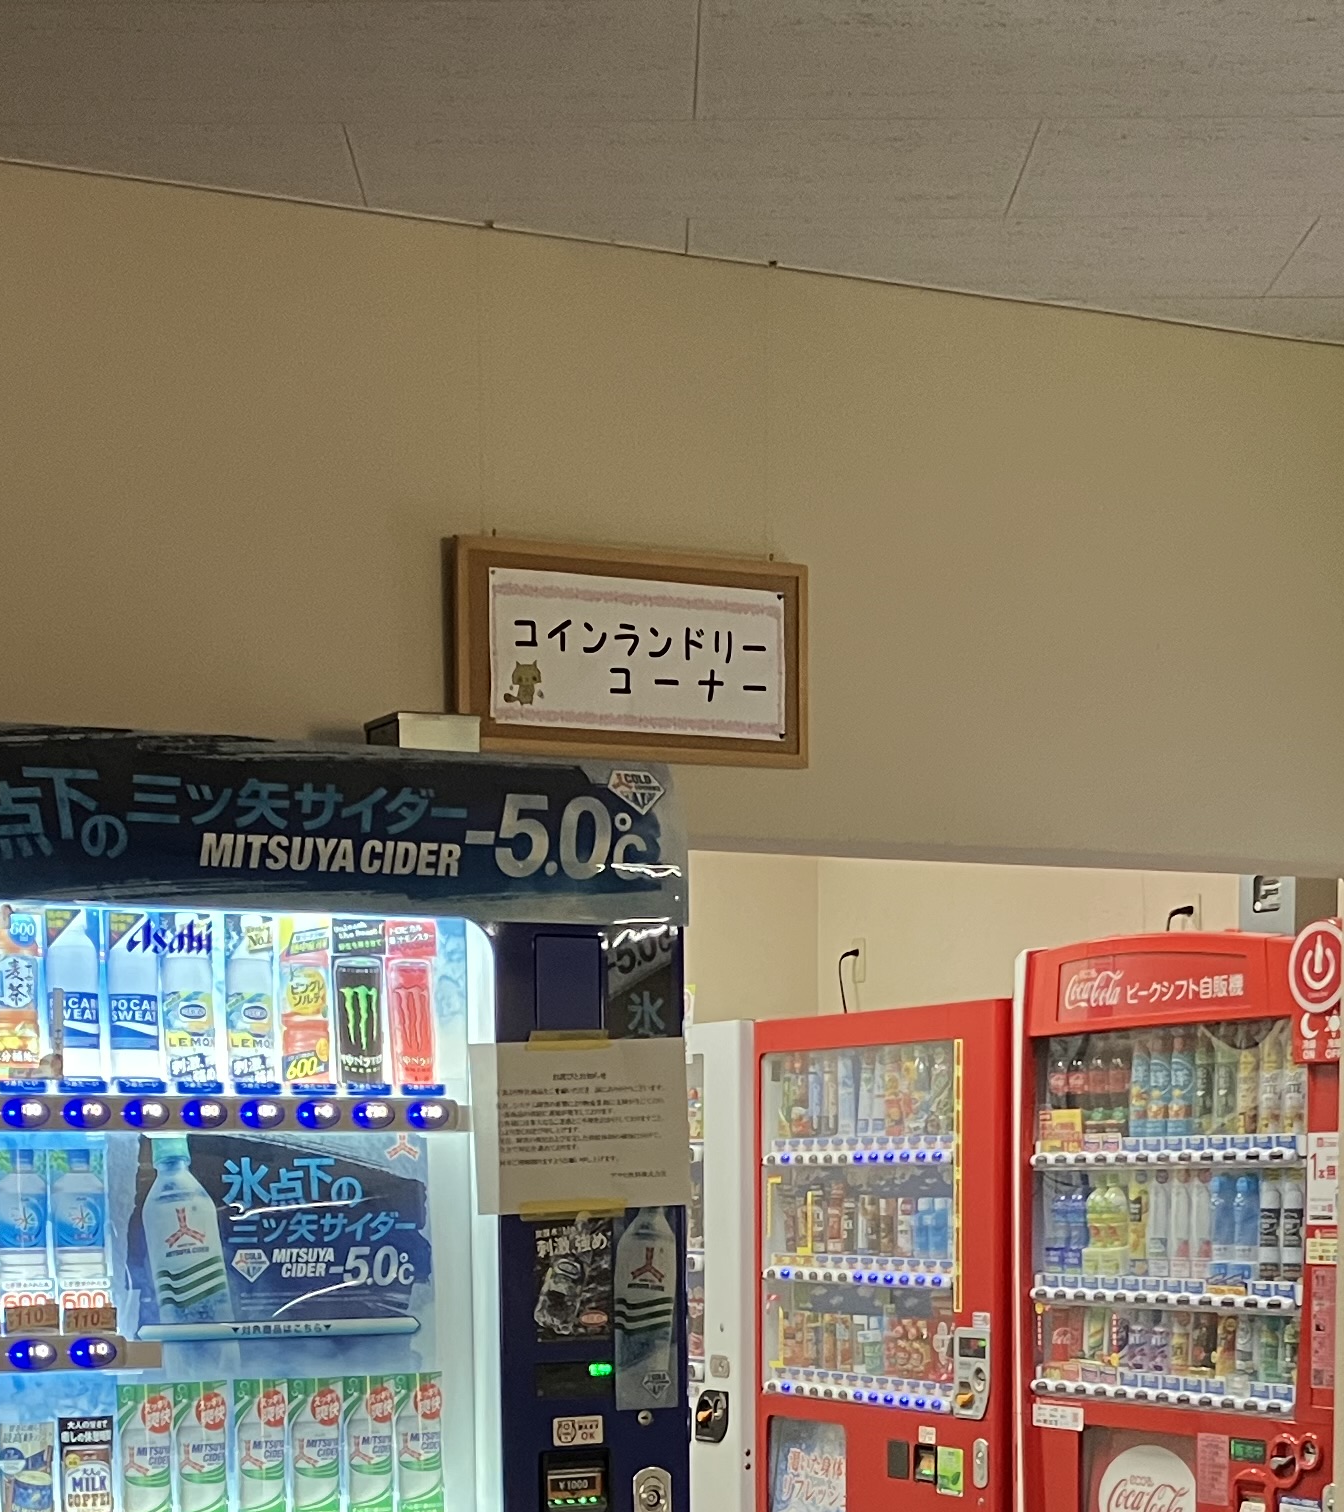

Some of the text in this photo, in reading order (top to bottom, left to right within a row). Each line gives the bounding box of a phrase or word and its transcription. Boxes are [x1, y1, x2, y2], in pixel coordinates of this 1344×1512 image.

[513, 618, 767, 664] コインランドリー
[608, 666, 767, 702] コーナー
[125, 773, 469, 836] 三ツ矢サイダー
[199, 832, 463, 877] MITSUYA CIDER
[9, 923, 35, 935] 600
[127, 916, 213, 955] Asahi
[4, 958, 28, 1006] 麦茶
[1126, 973, 1244, 1005] ピークシフト自販機
[221, 1156, 364, 1208] 氷点下の
[227, 1210, 417, 1244] 三ツ矢サイダー
[271, 1246, 336, 1264] MITSUYA
[280, 1262, 327, 1279] CIDER
[240, 1322, 324, 1336] 対象商品はこちら
[580, 1431, 596, 1441] OK
[71, 1475, 108, 1492] MILK
